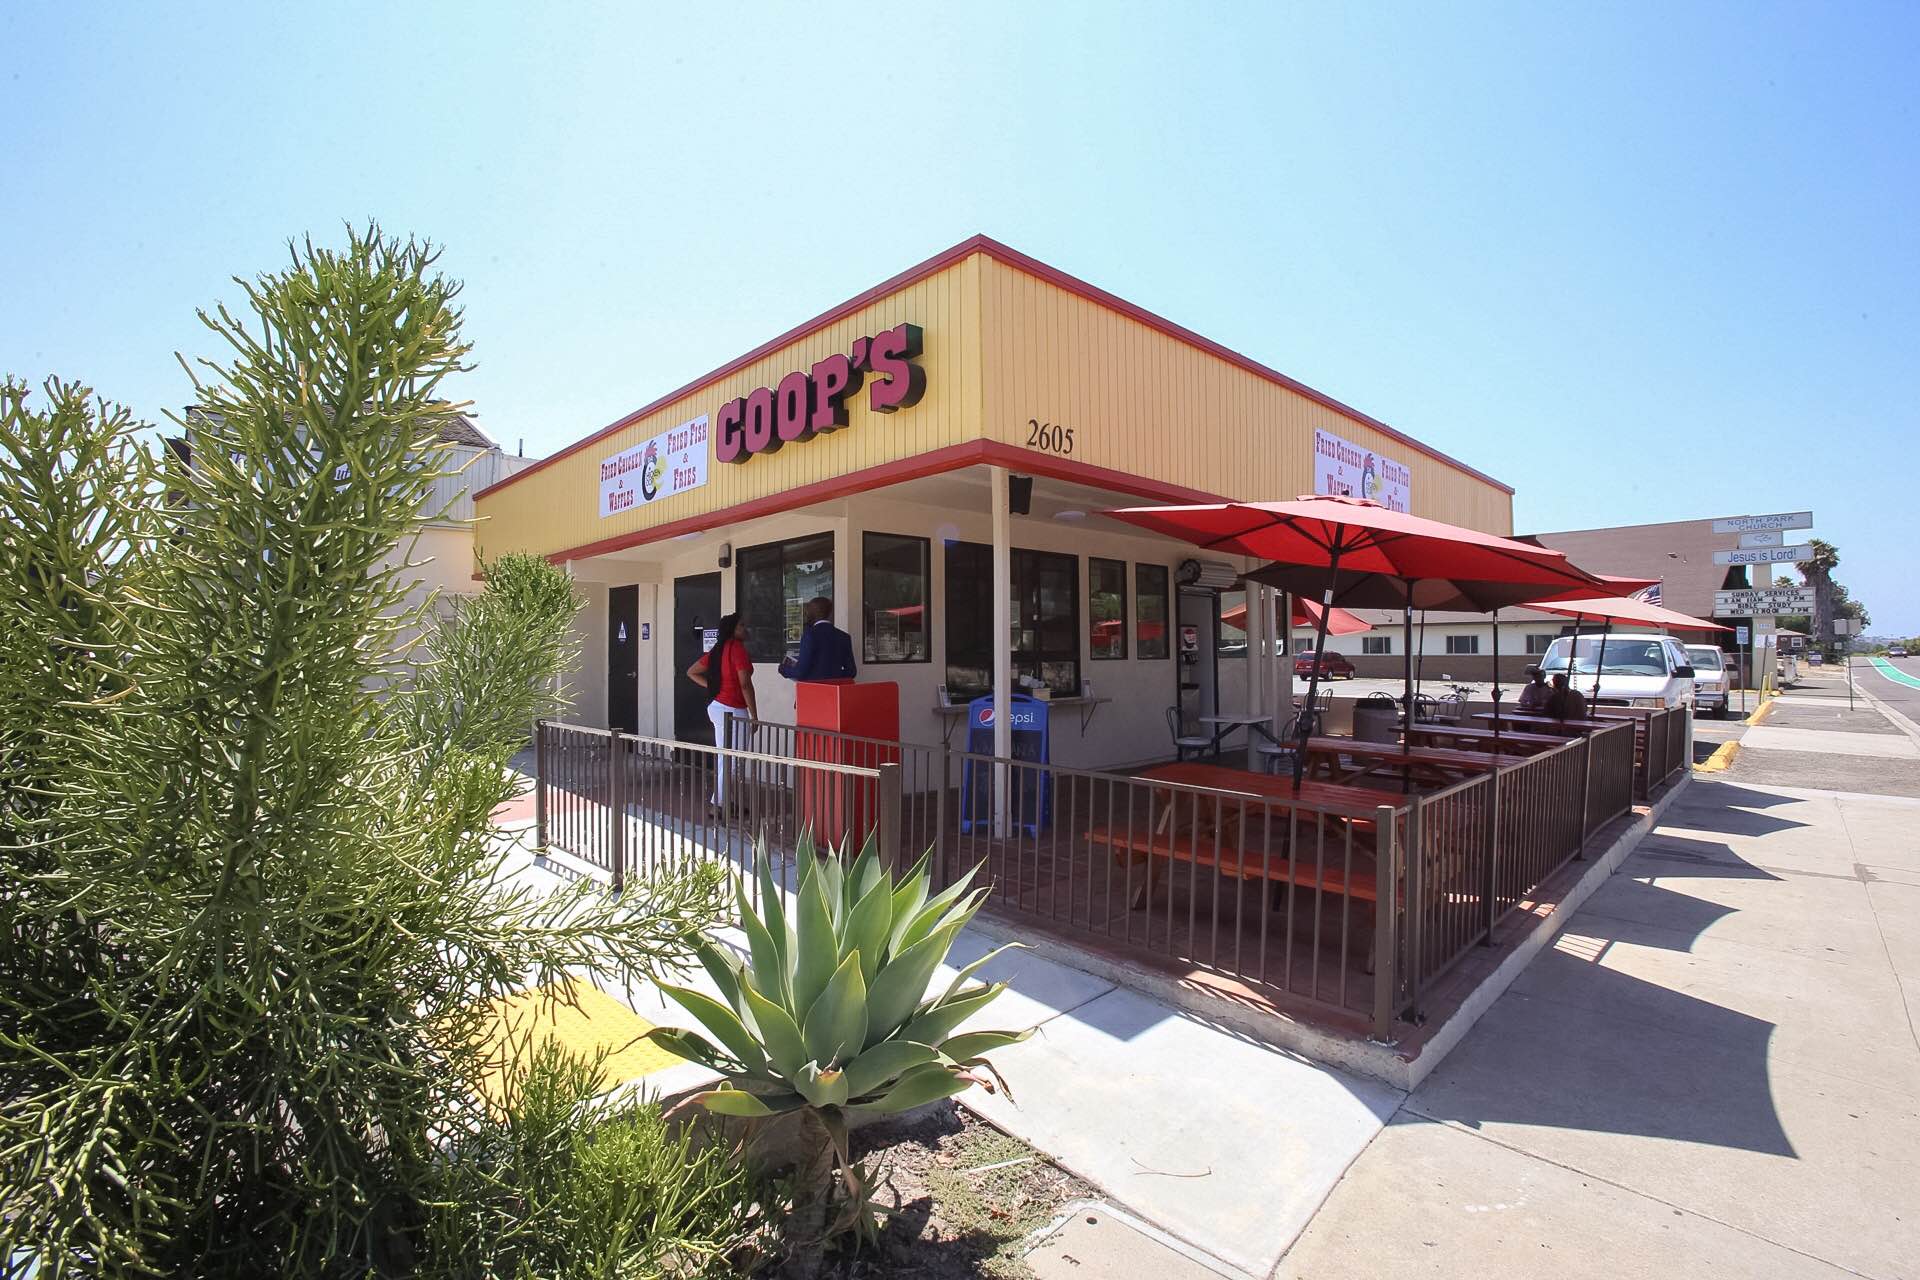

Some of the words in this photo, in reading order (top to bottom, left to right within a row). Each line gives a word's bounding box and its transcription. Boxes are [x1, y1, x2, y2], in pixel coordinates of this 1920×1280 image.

[716, 322, 926, 464] COOP'S
[1027, 419, 1074, 454] 2605
[682, 453, 689, 464] &
[1337, 466, 1344, 476] &
[1728, 517, 1762, 527] NORTH
[1766, 515, 1795, 523] PARK
[1738, 522, 1783, 531] CHURCH
[1727, 551, 1757, 563] Jesus
[1759, 552, 1768, 561] is
[1770, 548, 1797, 561] Lord!
[1764, 589, 1800, 597] SERVICES
[1010, 712, 1034, 725] epsi
